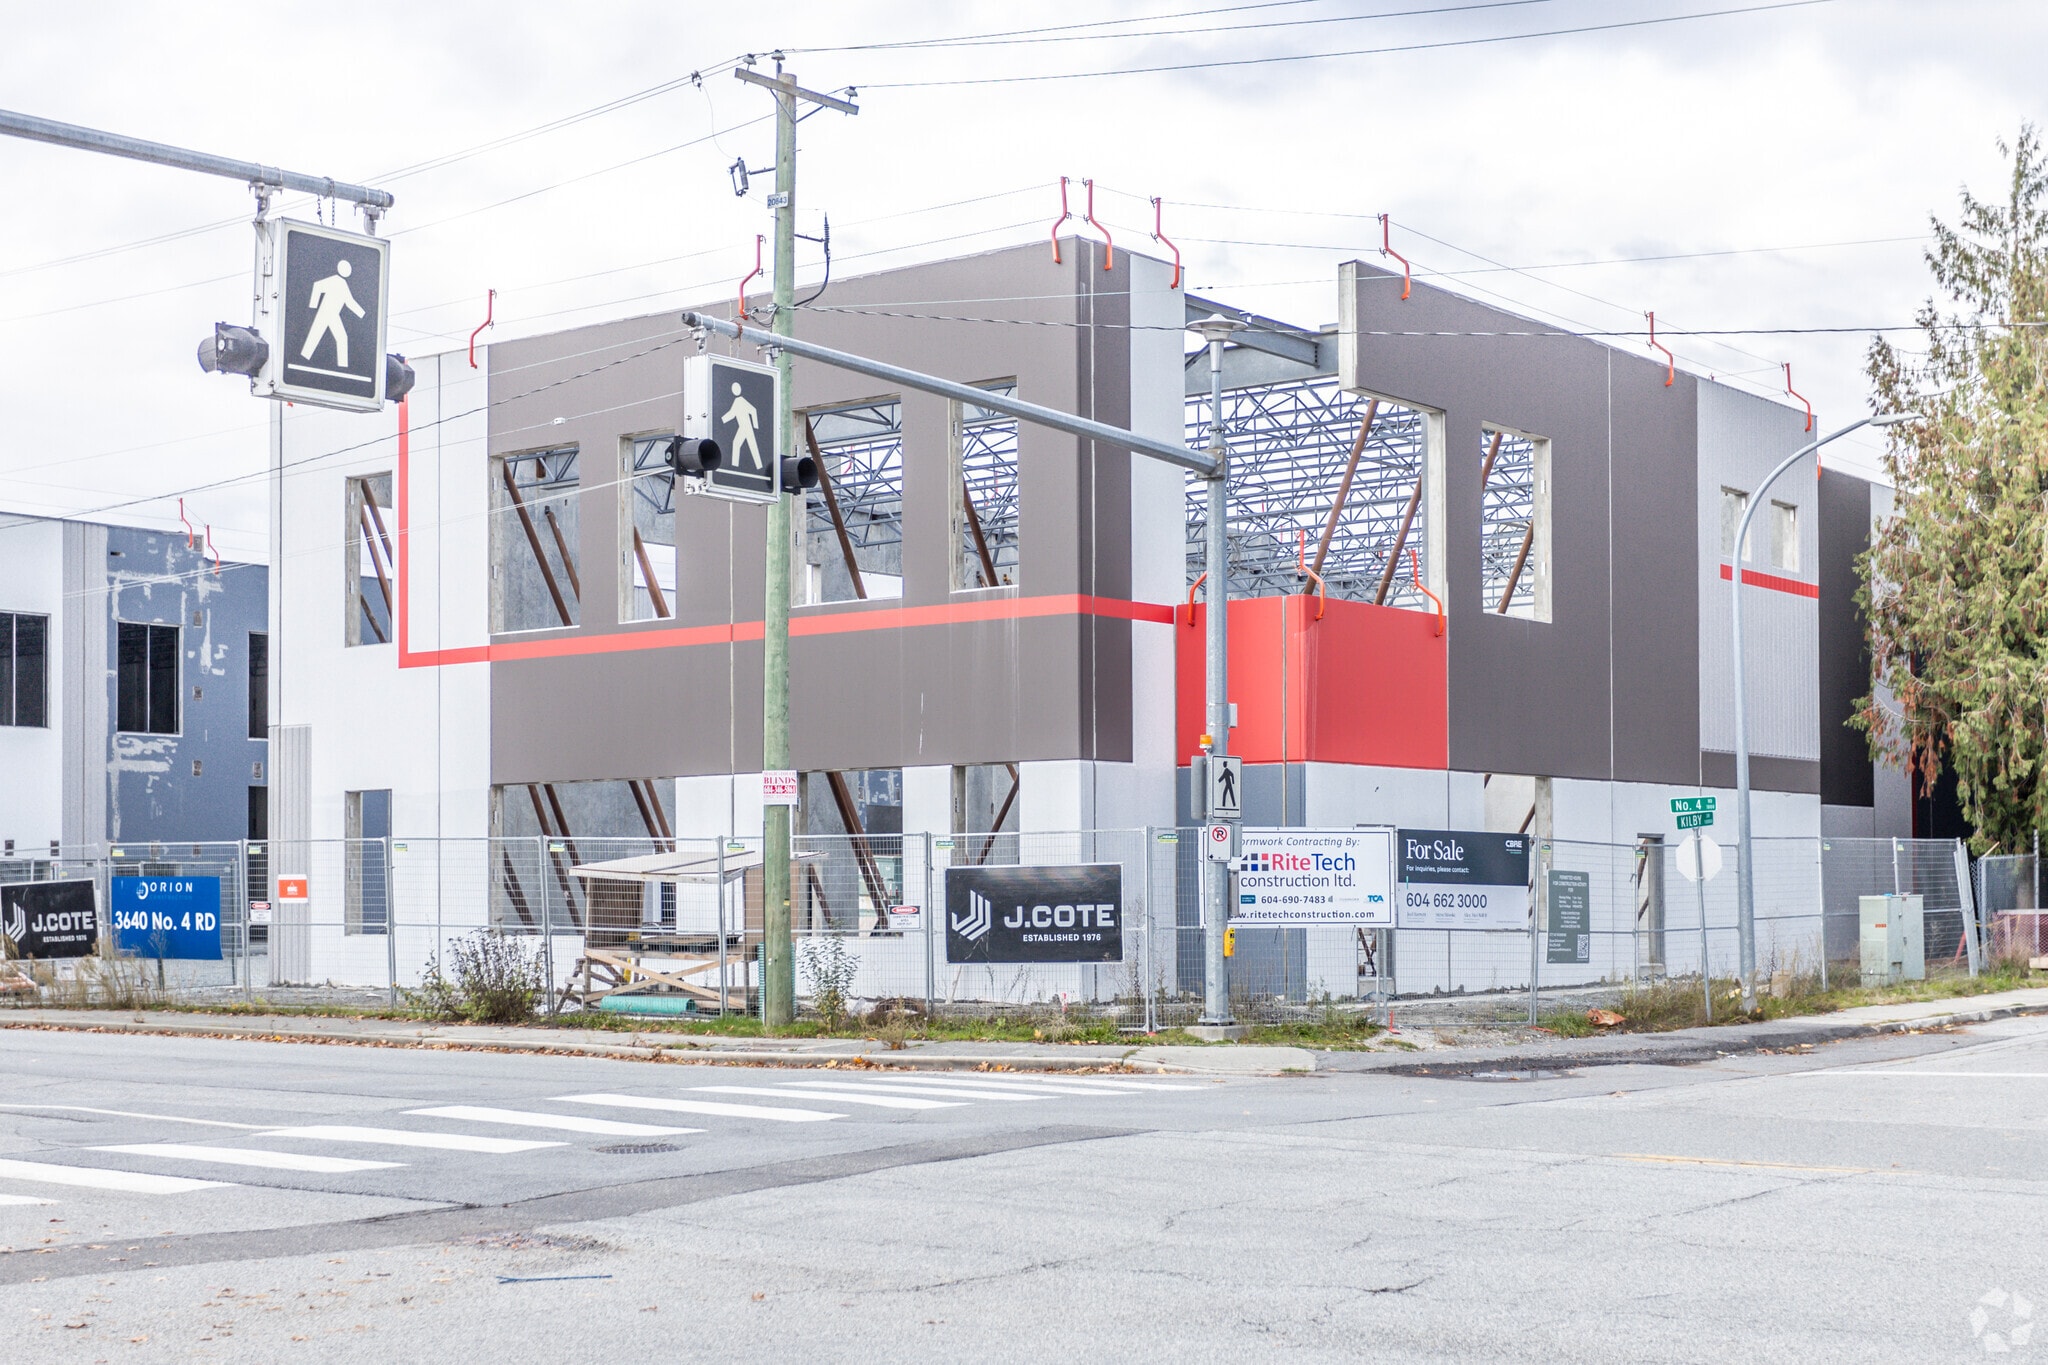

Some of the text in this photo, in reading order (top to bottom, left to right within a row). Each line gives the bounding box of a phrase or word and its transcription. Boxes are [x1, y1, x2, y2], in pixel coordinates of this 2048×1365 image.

[1675, 799, 1692, 811] No.
[1695, 799, 1702, 810] 4
[1680, 814, 1702, 828] KILBY
[1241, 836, 1360, 848] ormwork Contracting By:
[1505, 840, 1522, 848] CBRE
[1406, 839, 1464, 860] For Sale
[1272, 852, 1355, 871] RiteTech
[150, 882, 193, 892] ORION
[1240, 873, 1356, 887] construction ltd.
[1261, 895, 1326, 904] 604-690-7483
[1406, 892, 1488, 908] 604 662 3000
[32, 911, 94, 932] J.COTE
[115, 911, 216, 931] 3640 No. 4 RD
[1003, 904, 1114, 928] J.COTE
[1023, 933, 1079, 942] ESTABLISHED
